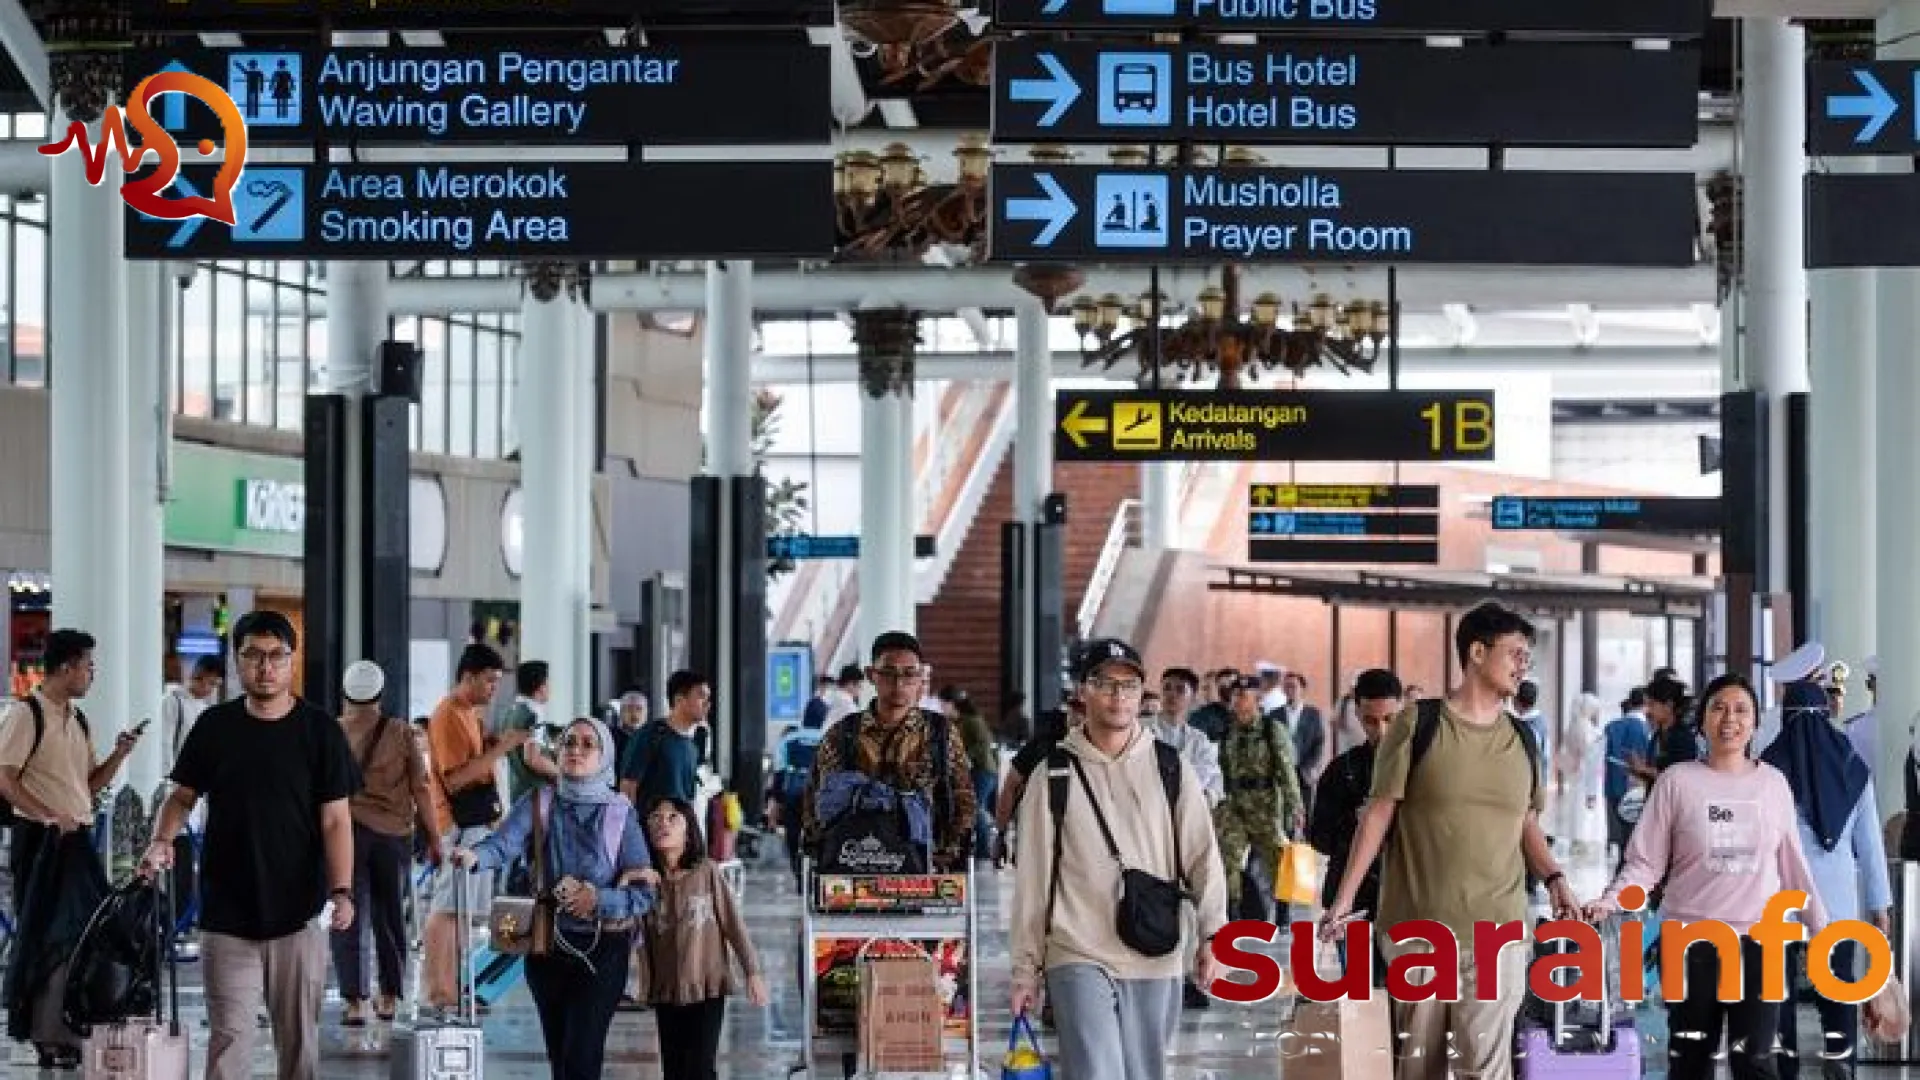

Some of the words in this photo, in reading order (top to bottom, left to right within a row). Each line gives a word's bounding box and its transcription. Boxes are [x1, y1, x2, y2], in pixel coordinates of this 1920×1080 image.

[1310, 0, 1376, 19] Bus
[318, 53, 485, 91] Anjungan
[498, 51, 679, 87] Pengantar
[1187, 54, 1254, 85] Bus
[1266, 54, 1356, 84] Hotel
[318, 95, 448, 134] Waving
[460, 92, 586, 131] Gallery
[1187, 97, 1277, 127] Hotel
[1291, 97, 1356, 128] Bus
[320, 169, 404, 199] Area
[416, 167, 568, 198] Merokok
[1184, 175, 1342, 208] Musholla
[320, 211, 473, 247] Smoking
[484, 210, 569, 241] Area
[1184, 219, 1298, 254] Prayer
[1308, 219, 1411, 250] Room
[1169, 402, 1307, 429] Kedatangan
[1420, 402, 1493, 451] 1B
[1170, 428, 1257, 450] Arrivals
[1708, 805, 1734, 823] Be
